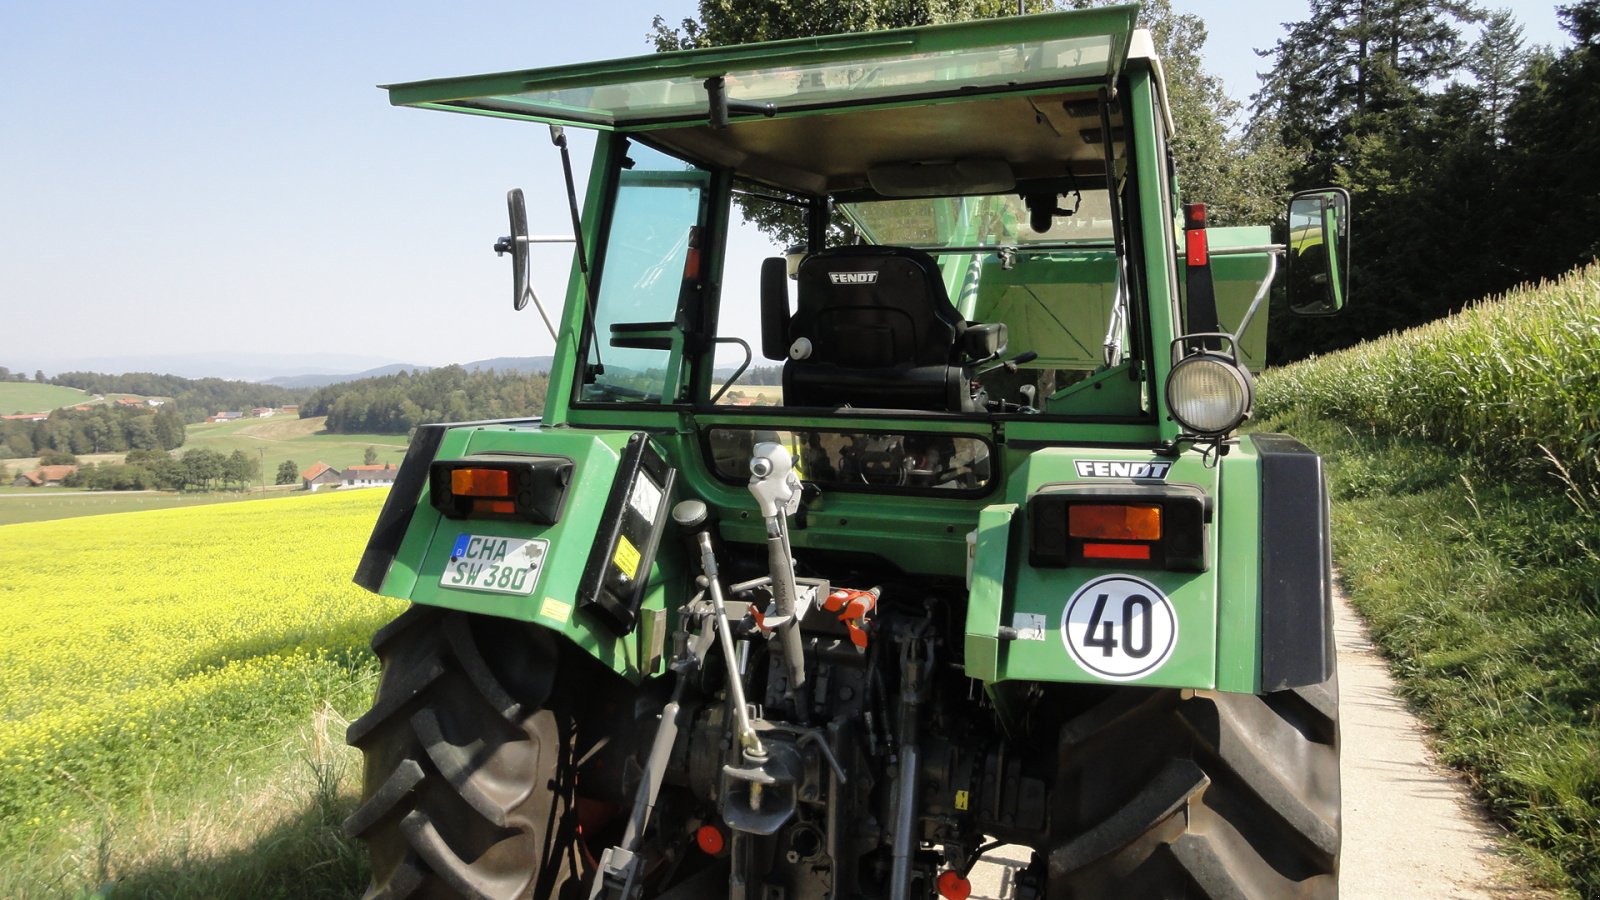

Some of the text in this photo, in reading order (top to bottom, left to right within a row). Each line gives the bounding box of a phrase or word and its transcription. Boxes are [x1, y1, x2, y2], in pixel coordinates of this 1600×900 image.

[831, 273, 877, 283] FENDT
[1077, 462, 1169, 478] FENDT
[456, 548, 463, 556] D
[466, 537, 508, 562] CHA
[451, 562, 528, 590] SW 380
[1083, 593, 1153, 659] 40
